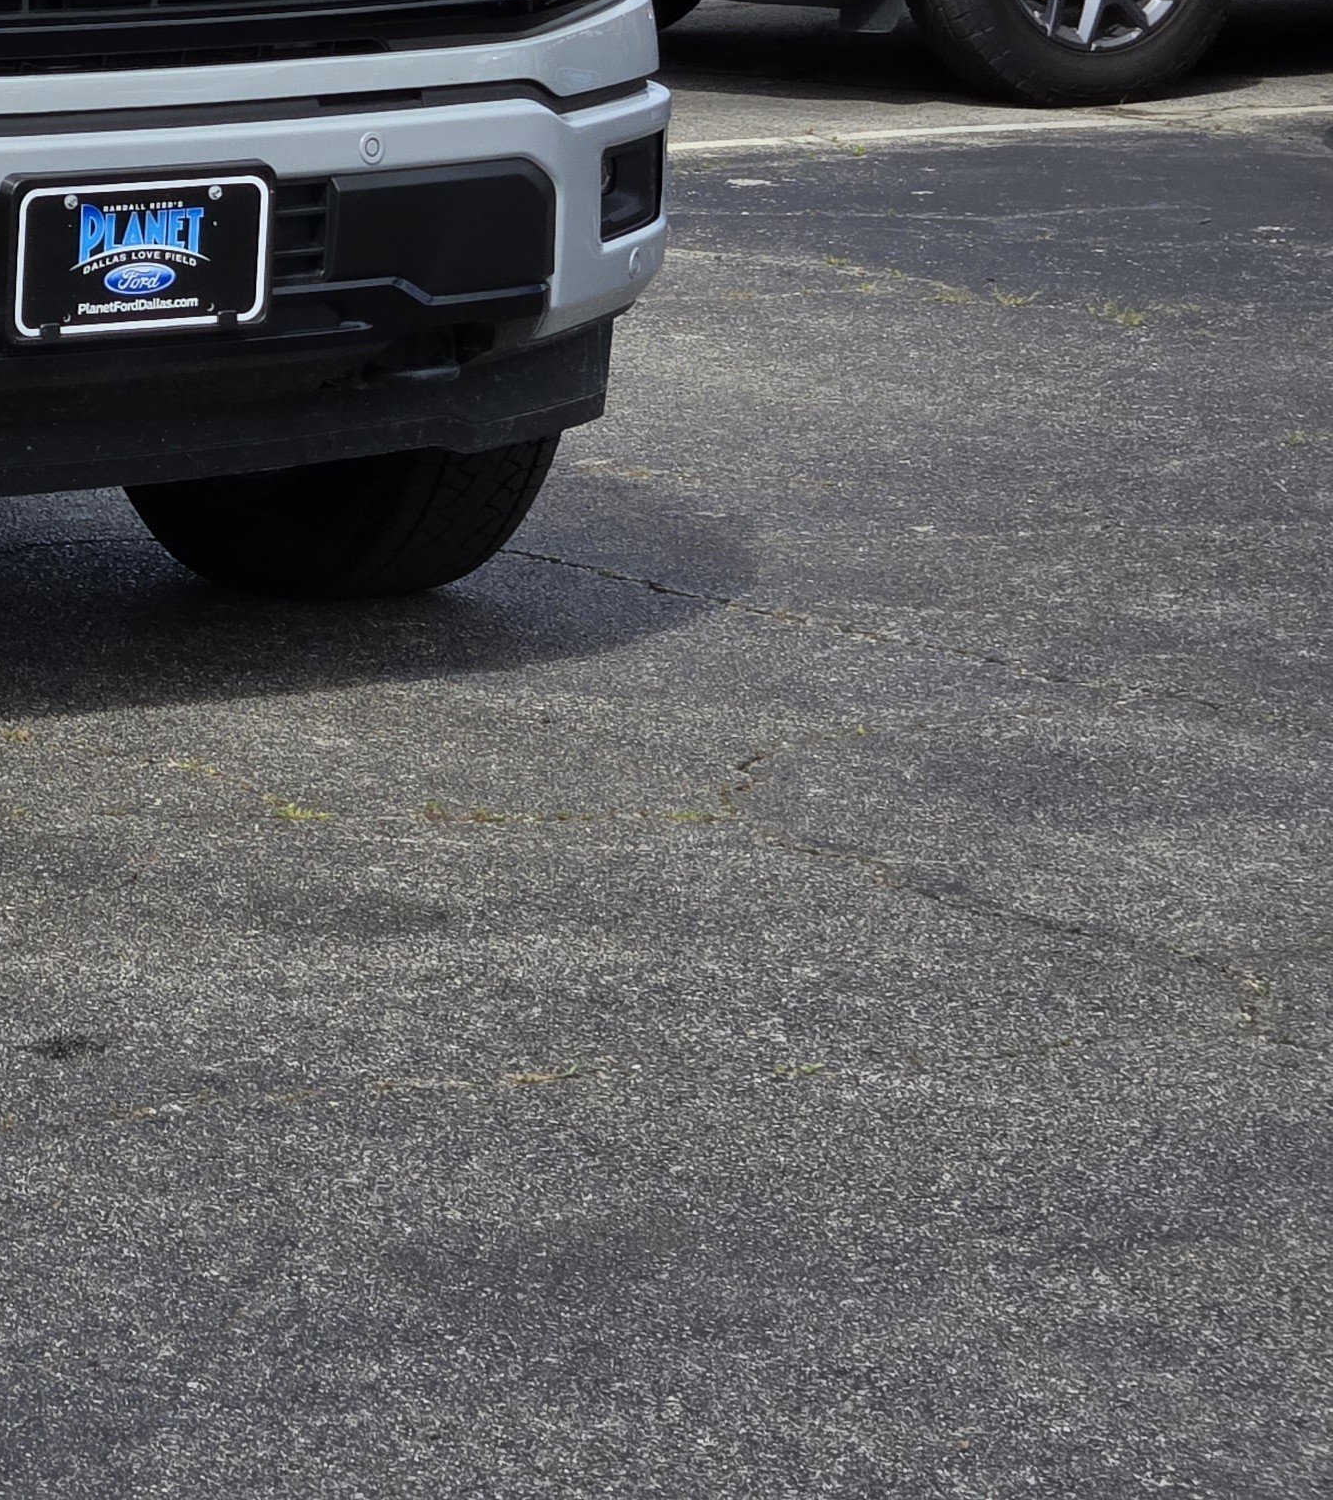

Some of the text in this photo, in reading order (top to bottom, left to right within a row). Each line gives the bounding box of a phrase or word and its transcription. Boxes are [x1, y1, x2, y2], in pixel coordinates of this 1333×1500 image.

[79, 203, 205, 265] PLANET
[82, 251, 197, 275] DALLAS LOVE FIELD
[117, 268, 160, 290] Ford
[77, 297, 199, 315] PlanetFordDallas.com
